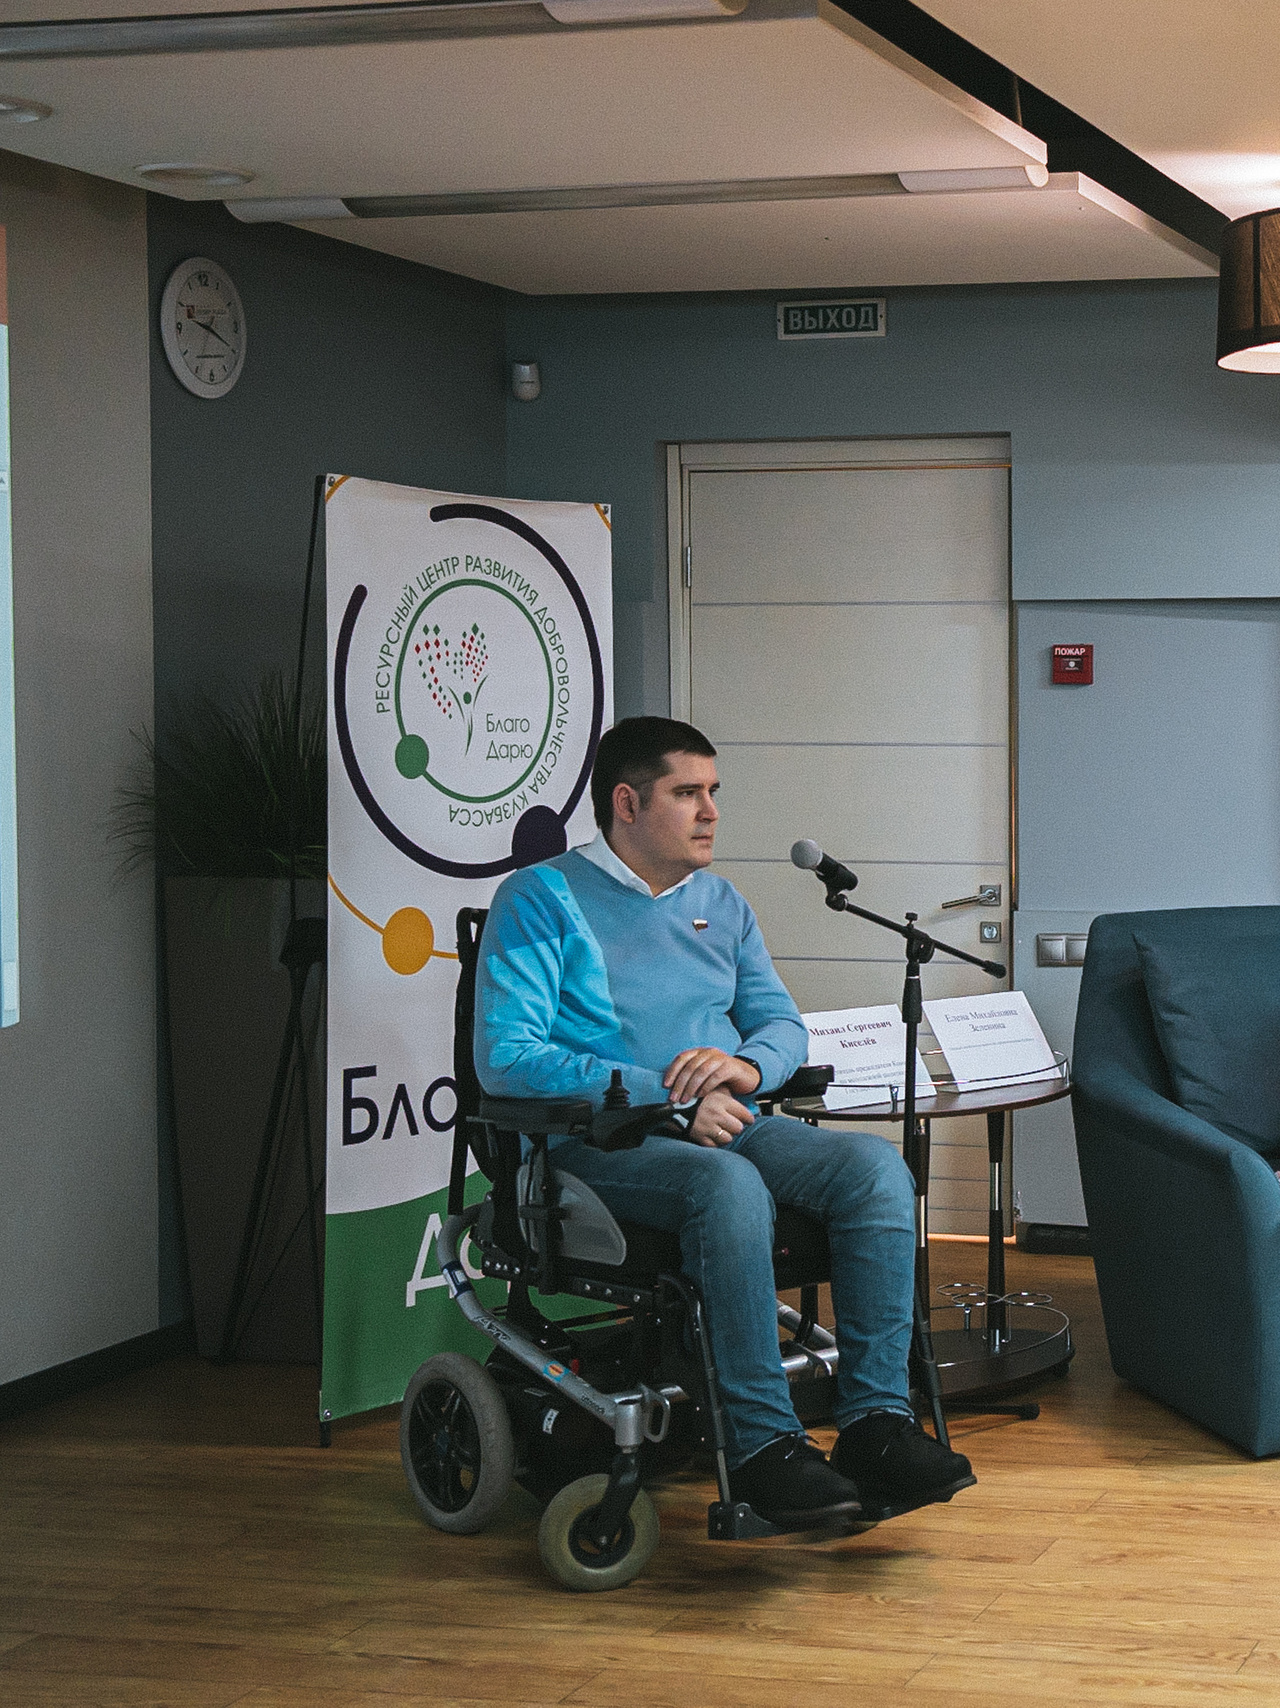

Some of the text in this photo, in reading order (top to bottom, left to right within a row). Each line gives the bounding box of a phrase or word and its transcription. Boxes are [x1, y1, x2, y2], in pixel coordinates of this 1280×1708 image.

[788, 307, 875, 331] ВЫХОД
[416, 556, 460, 592] ЦЕНТР
[464, 554, 540, 607] РАЗВИТИЯ
[375, 584, 419, 713] РЕСУРСНЫЙ
[1054, 647, 1086, 656] ПОЖАР
[486, 713, 531, 733] Благо
[485, 740, 534, 763] Дарю
[448, 790, 530, 827] КУЗБАССА
[809, 1020, 893, 1037] Михаил Сергеевич
[840, 1037, 878, 1049] Киселёв
